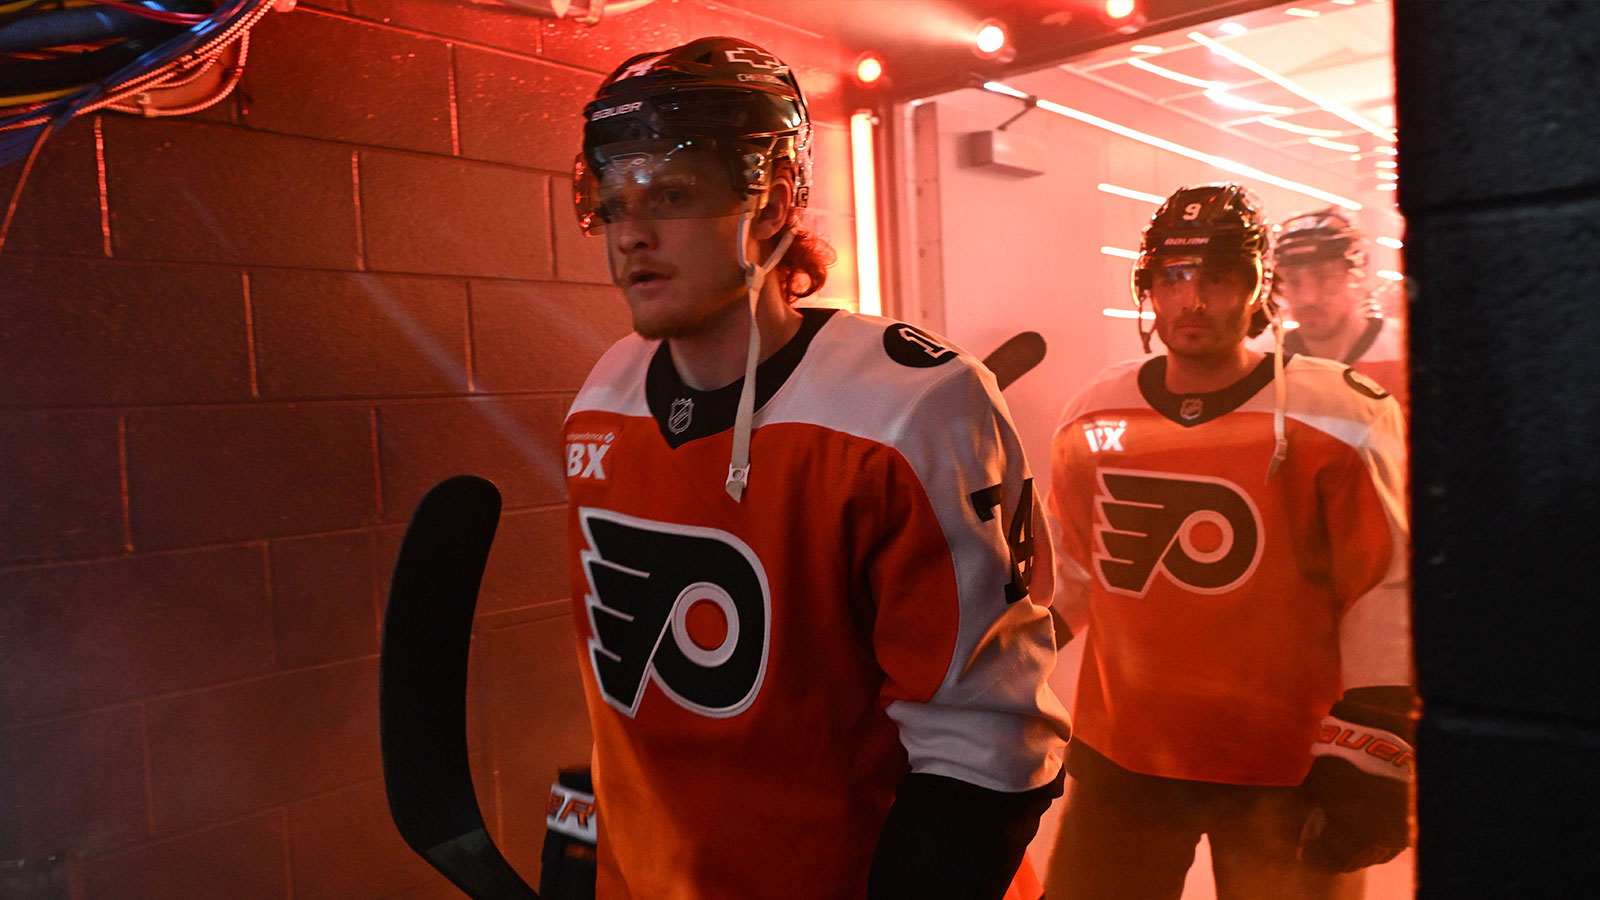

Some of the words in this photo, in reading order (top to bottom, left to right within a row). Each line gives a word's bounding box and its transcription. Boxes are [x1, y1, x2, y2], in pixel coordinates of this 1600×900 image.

[590, 101, 643, 122] BAUER
[1182, 203, 1202, 220] 9
[898, 327, 946, 359] 1
[565, 442, 611, 480] BX
[970, 477, 1034, 605] 74
